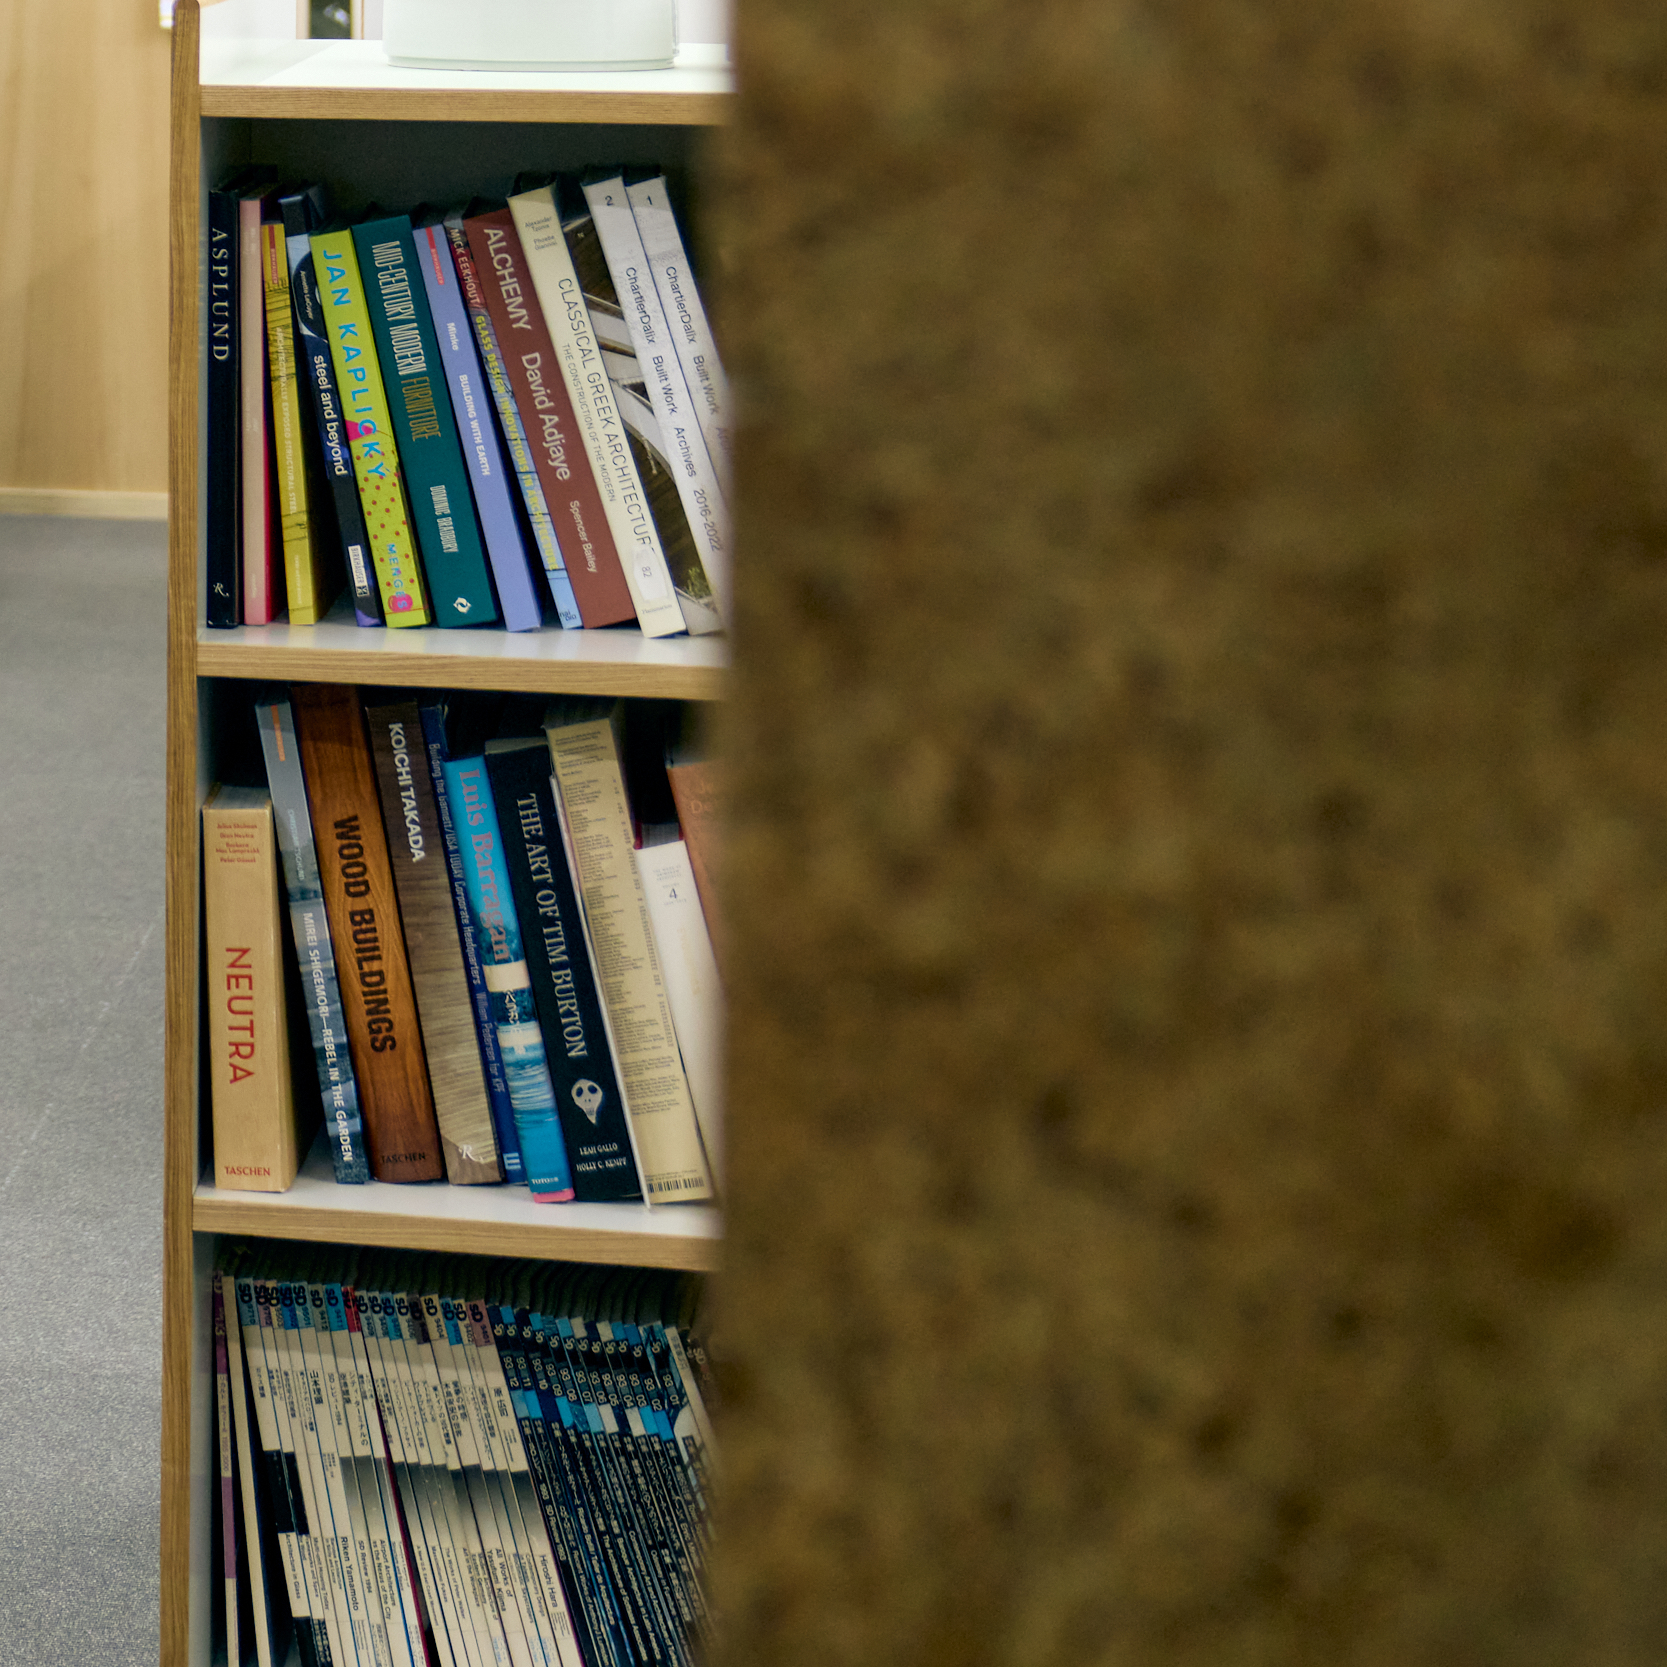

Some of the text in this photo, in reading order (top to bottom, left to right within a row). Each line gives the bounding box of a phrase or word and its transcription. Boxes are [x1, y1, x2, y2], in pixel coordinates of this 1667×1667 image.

[211, 227, 231, 362] ASPLUND
[450, 228, 481, 306] MICK EEKHOUT
[483, 228, 532, 331] ALCHEMY
[323, 249, 392, 478] JAN KAPLICKÝ
[371, 240, 441, 442] MID-CENTURY MODERN FURNITURE
[446, 322, 460, 351] Minke
[665, 265, 720, 416] ChartierDalix Built Work
[313, 355, 346, 476] steel and beyond
[459, 374, 491, 476] BUILDING WITH EARTH
[475, 316, 491, 345] GLASS
[484, 348, 504, 390] DESIGN
[497, 392, 527, 472] INNOVATIONS
[524, 486, 558, 571] ARCHITECTURE
[522, 352, 571, 481] David Adjaye
[559, 277, 656, 556] CLASSICAL GREEK ARCHITECTUR
[562, 344, 573, 361] THE
[568, 362, 590, 423] CONSTRUCTION
[590, 441, 599, 458] THE
[595, 460, 616, 502] MODERN
[626, 266, 722, 552] ChartierDalix Built Work Archives 2016-2022
[430, 484, 459, 553] DOMINIC BRADBURY
[569, 500, 598, 574] Spencer Bailey
[388, 721, 426, 863] KOICHI TAKADA
[429, 742, 442, 781] Building
[437, 783, 447, 798] the
[455, 880, 471, 925] Corporate
[463, 925, 482, 985] Headquarters
[458, 769, 513, 962] Luis Barragan
[517, 793, 589, 1058] THE ART OF TIM BURTON
[303, 911, 316, 948] MIREI
[333, 814, 397, 1054] WOOD BUILDINGS
[225, 946, 255, 1085] NEUTRA
[331, 1084, 343, 1106] THE
[335, 1110, 353, 1162] GARDEN
[380, 1151, 426, 1166] TASCHEN
[224, 1165, 271, 1177] TASCHEN
[341, 1536, 359, 1611] Riken Yamamoto
[539, 1554, 558, 1608] Hiroshi Hara
